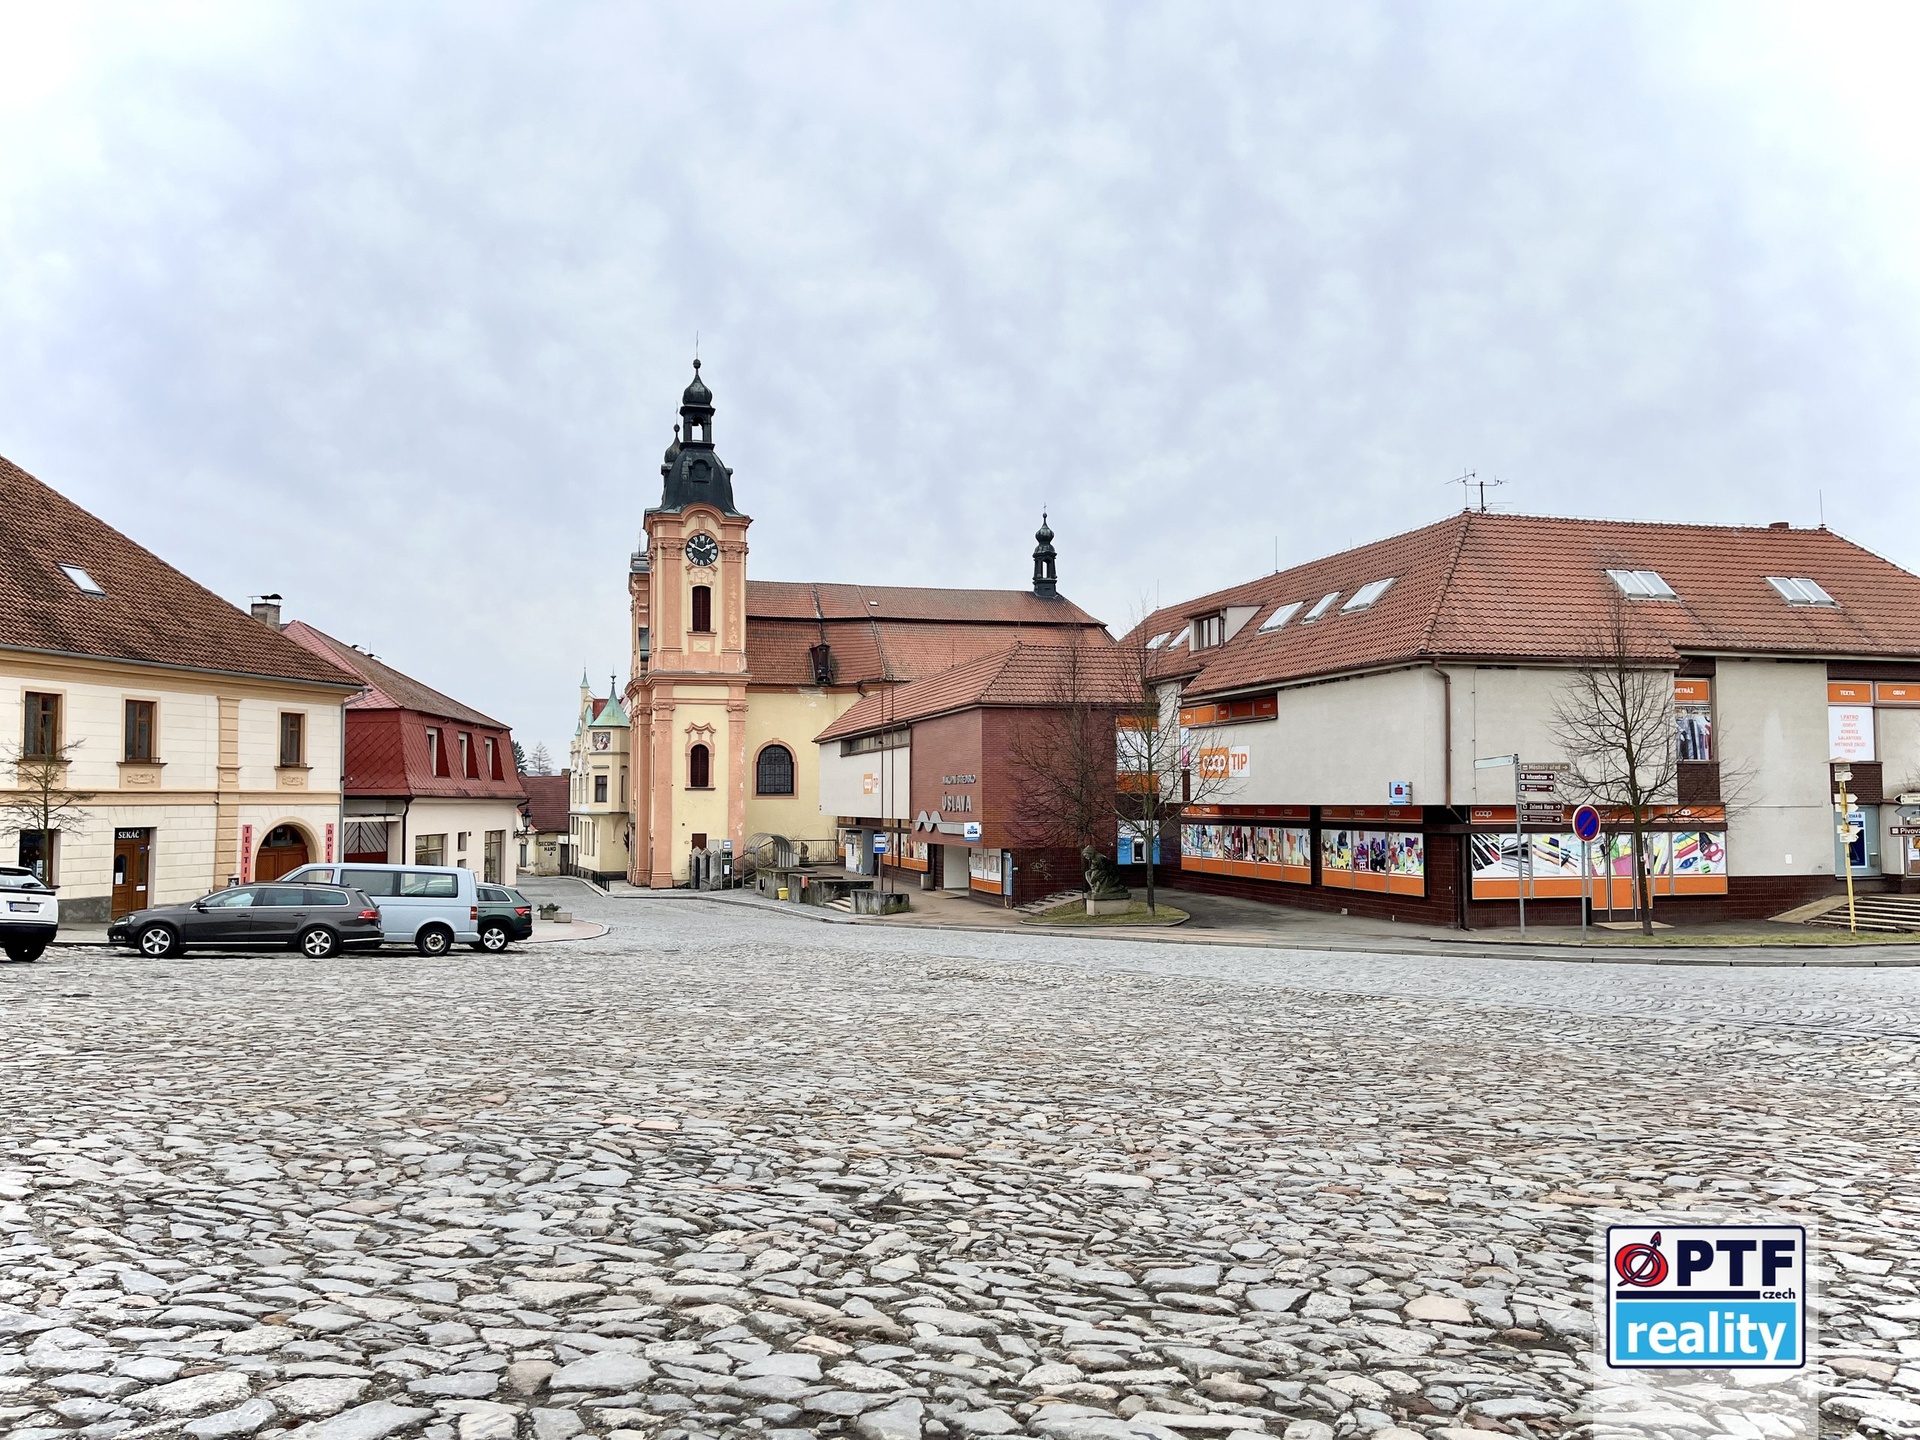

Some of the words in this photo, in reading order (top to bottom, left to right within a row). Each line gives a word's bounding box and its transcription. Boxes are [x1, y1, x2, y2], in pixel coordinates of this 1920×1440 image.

[1231, 753, 1248, 770] TIP
[1475, 810, 1493, 818] coop
[118, 829, 140, 839] SEKÁČ
